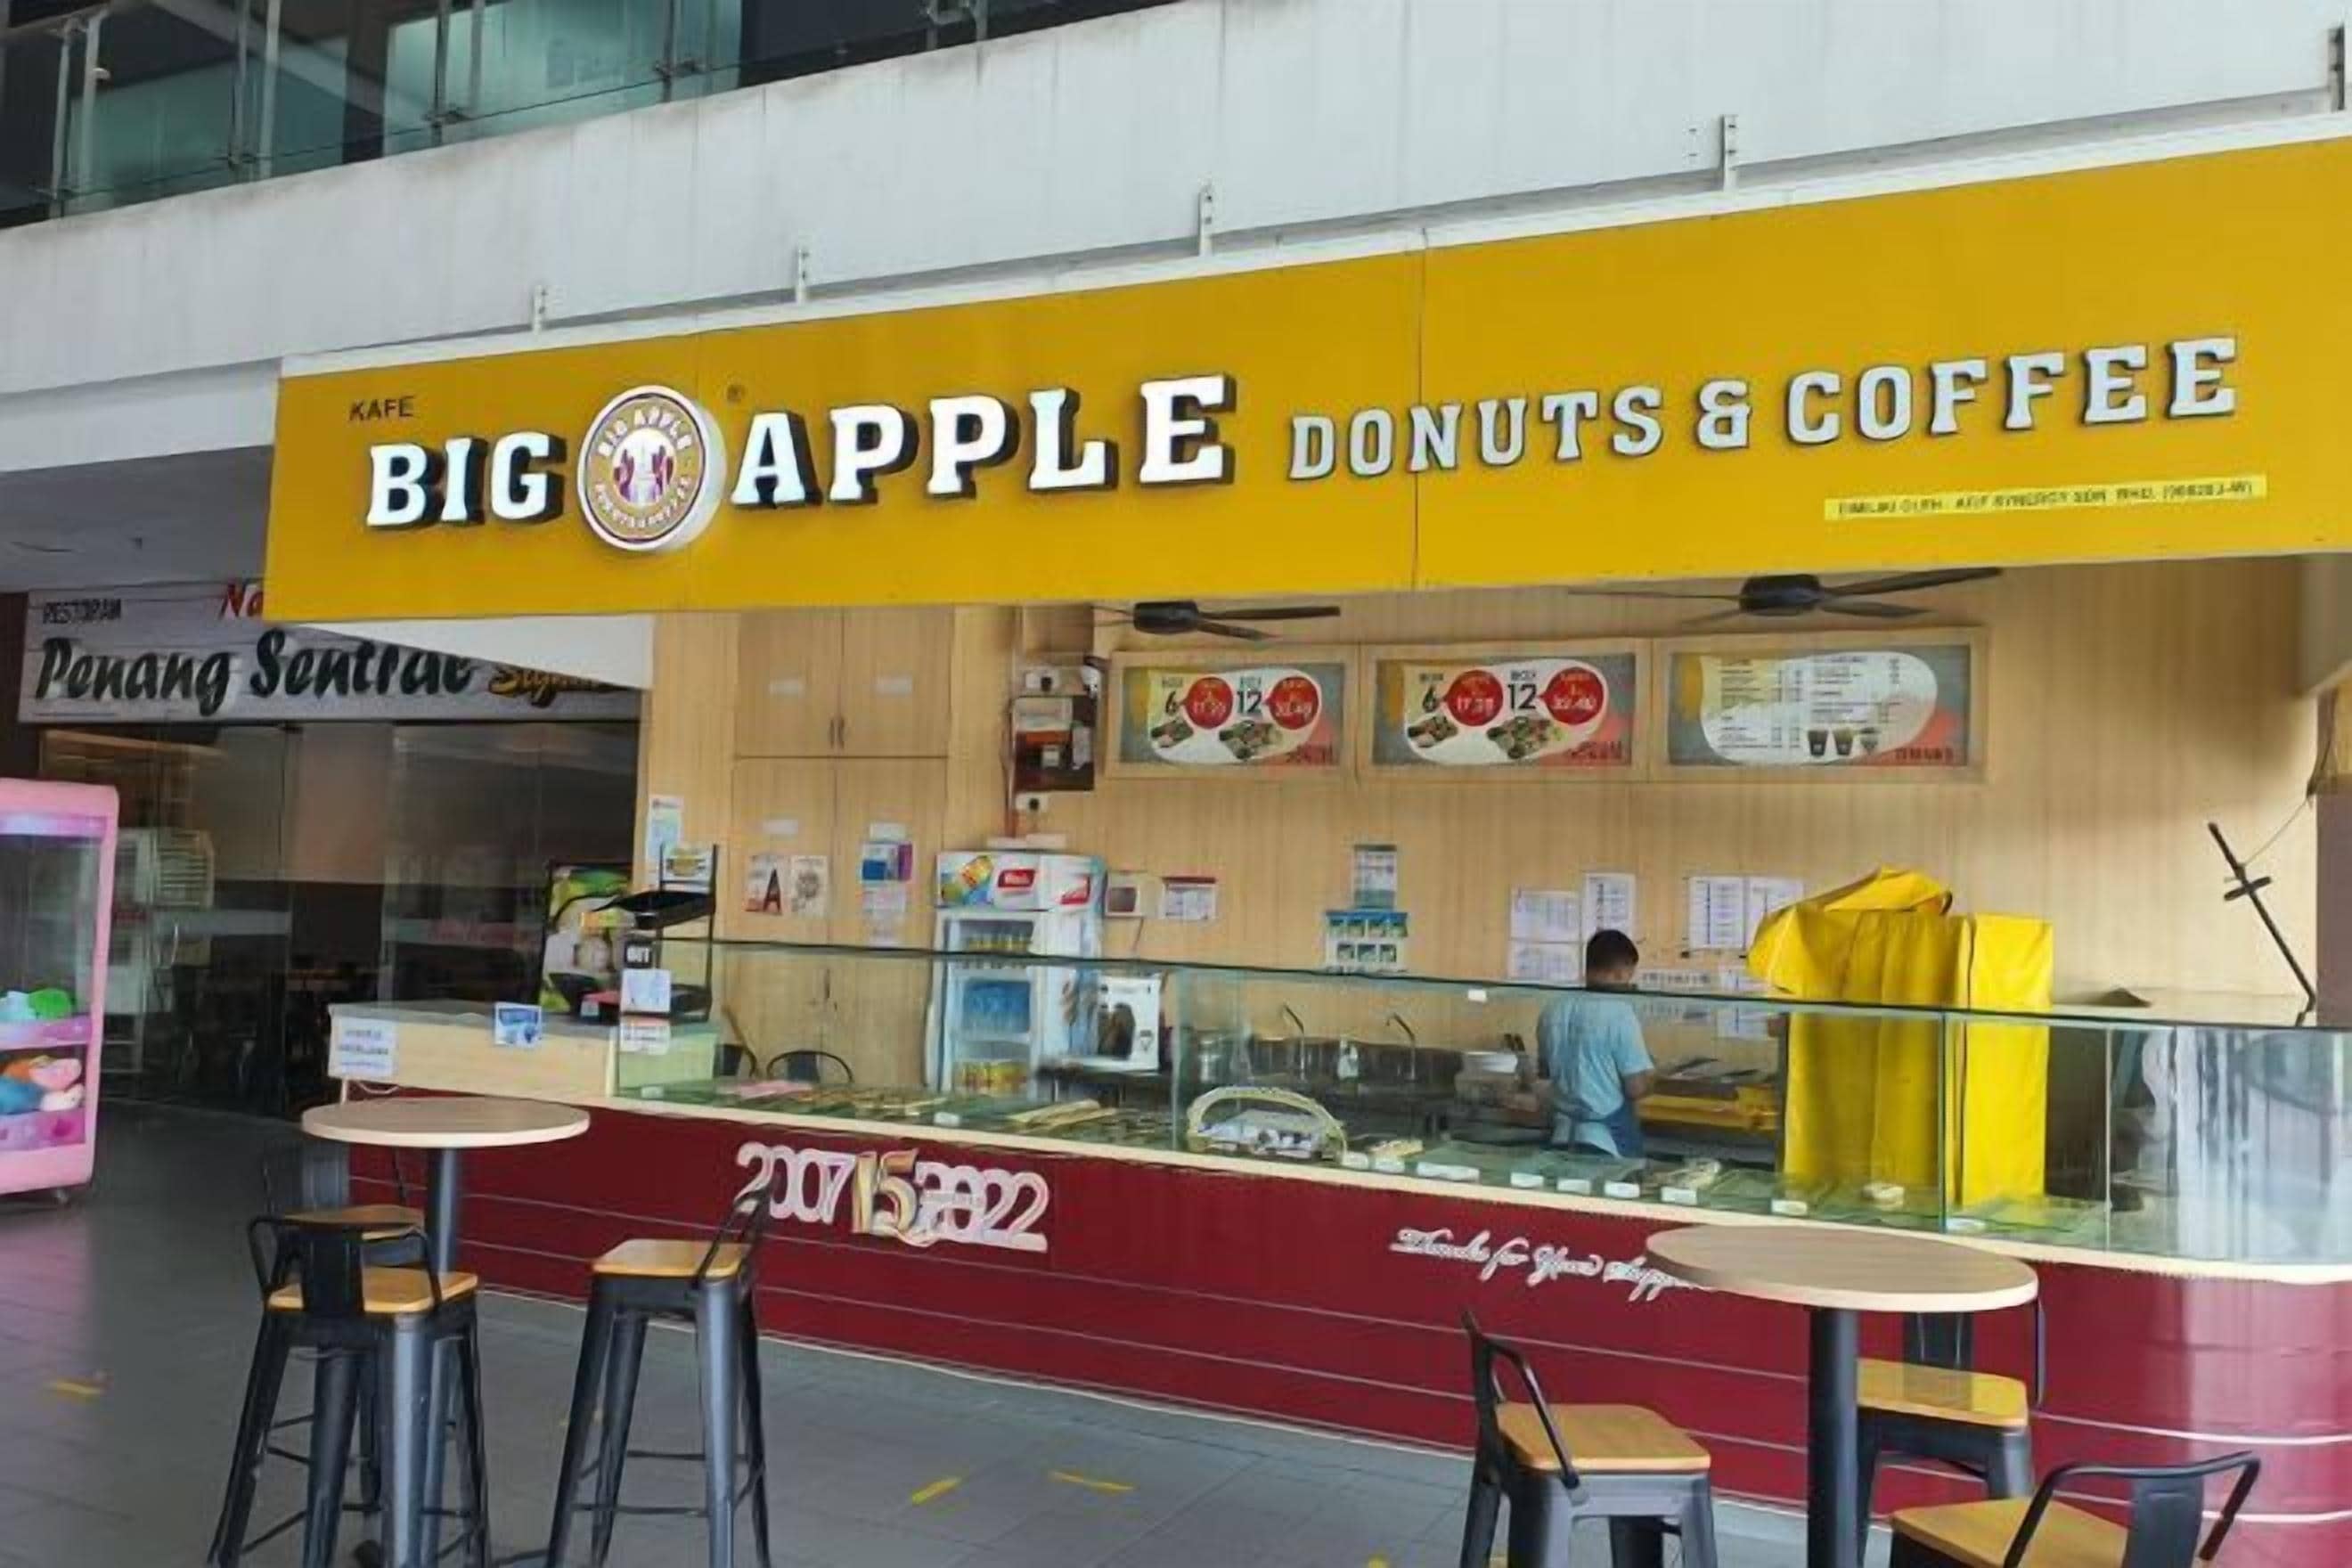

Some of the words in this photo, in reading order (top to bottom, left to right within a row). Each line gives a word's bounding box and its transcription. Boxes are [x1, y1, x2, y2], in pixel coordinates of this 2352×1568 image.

[348, 395, 415, 421] KAFE
[1288, 385, 1665, 481] DONUTS
[1696, 378, 1752, 450] &
[1787, 337, 2237, 446] COFFEE
[366, 431, 561, 527] BIG
[731, 373, 1233, 509] APPLE
[35, 636, 233, 716] Penang
[1164, 690, 1179, 715] 6
[1236, 690, 1263, 714] 12
[1421, 685, 1440, 714] 6
[1507, 682, 1537, 711] 12
[733, 1141, 857, 1224] 2007
